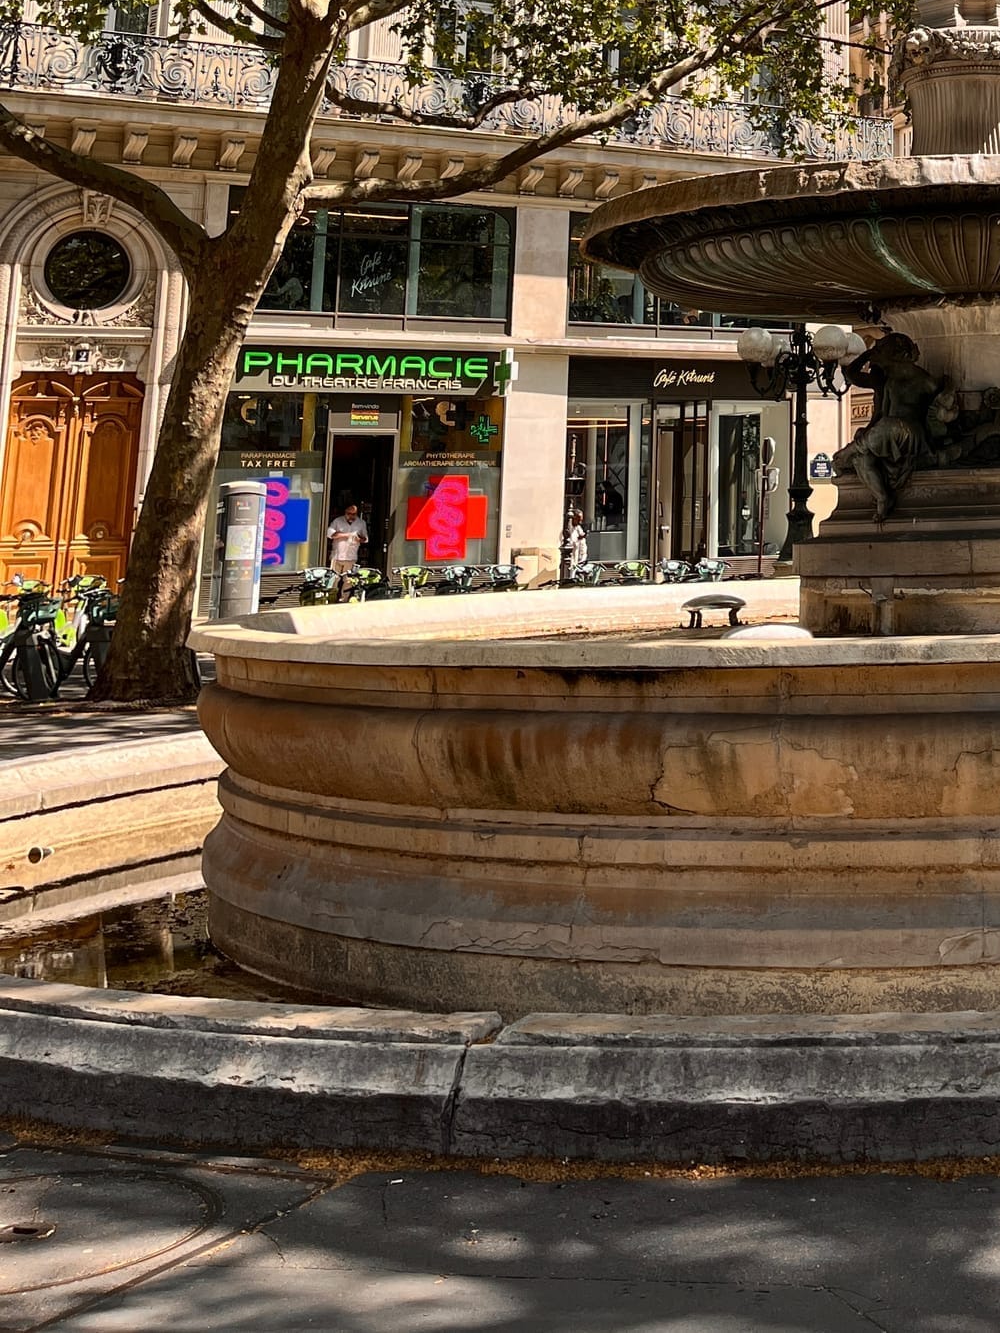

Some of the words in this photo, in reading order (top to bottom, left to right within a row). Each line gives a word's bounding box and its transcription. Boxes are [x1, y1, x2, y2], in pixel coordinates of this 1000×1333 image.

[79, 351, 87, 361] 2
[243, 351, 489, 379] PHARMACIE
[271, 376, 296, 387] DU
[301, 376, 378, 389] THEATRE
[383, 378, 462, 390] FRANCAIS
[653, 368, 678, 388] Café
[240, 460, 262, 468] TAX
[267, 460, 297, 468] FREE
